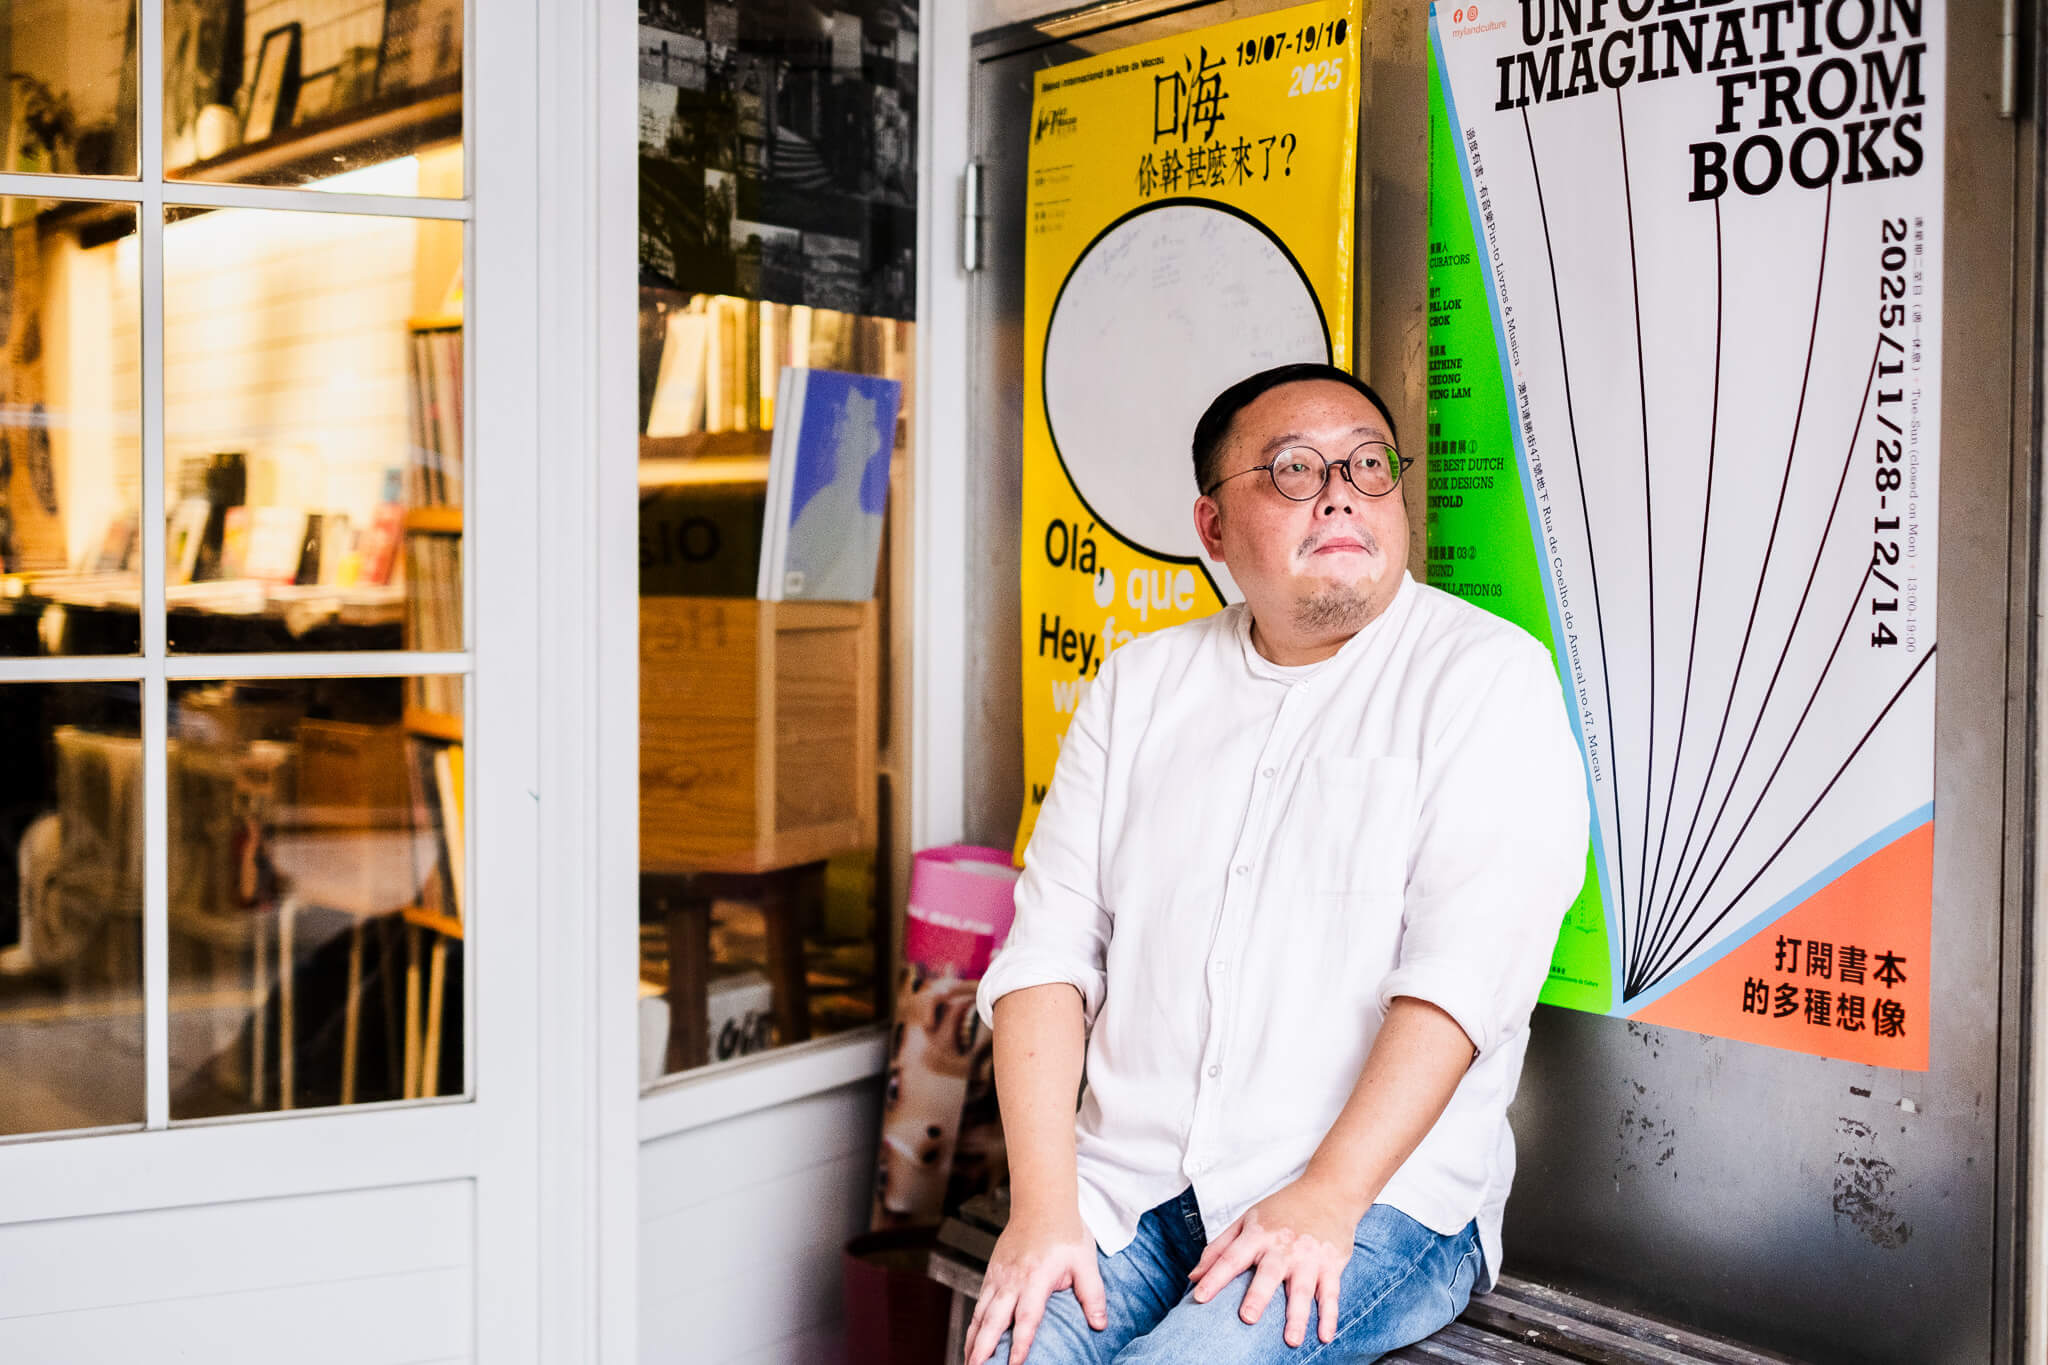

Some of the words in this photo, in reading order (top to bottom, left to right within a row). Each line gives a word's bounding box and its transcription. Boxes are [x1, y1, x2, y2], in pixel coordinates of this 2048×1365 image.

[1236, 18, 1348, 67] 19/07-19/10
[1452, 19, 1507, 39] mylandculture
[1287, 58, 1343, 98] 2025
[1494, 0, 1922, 111] IMAGINATION
[1153, 45, 1229, 145] 嗨
[1716, 43, 1926, 134] FROM
[1135, 133, 1297, 197] 你幹甚麼來了?
[1689, 112, 1924, 202] BOOKS
[1429, 253, 1470, 269] CURATORS
[1443, 299, 1462, 311] LOK
[1495, 262, 1509, 304] Livros
[1504, 305, 1513, 317] &
[1451, 387, 1471, 399] LAM
[1871, 217, 1907, 648] 2025/11/28-12/14
[1443, 458, 1466, 472] BEST
[1468, 457, 1504, 471] DUTCH
[1450, 476, 1494, 490] DESIGNS
[1543, 506, 1554, 534] Rua
[1909, 502, 1917, 519] on
[1045, 518, 1105, 586] Olá,
[1549, 536, 1558, 554] de
[1126, 567, 1196, 622] que
[1491, 583, 1502, 598] 03
[1553, 557, 1569, 608] Coelho
[1039, 613, 1100, 676] Hey,
[1564, 611, 1574, 630] do
[1569, 634, 1587, 687] Amaral
[1588, 735, 1602, 782] Macau
[1775, 934, 1907, 989] 打開書本
[1742, 976, 1907, 1038] 的多種想像
